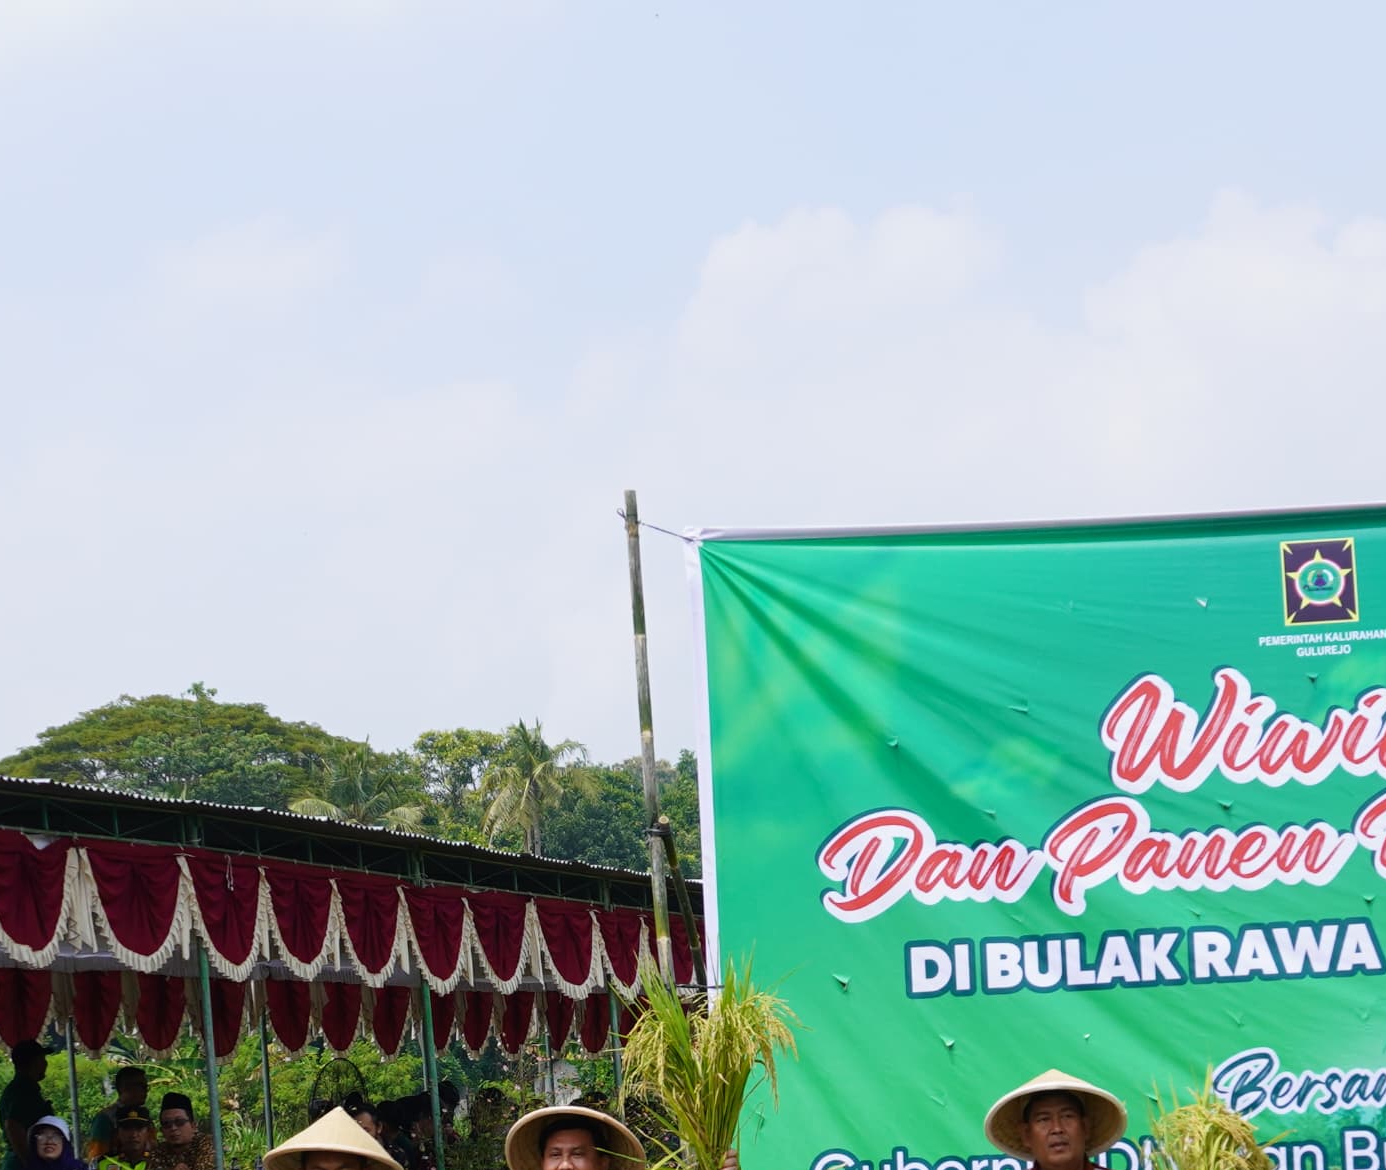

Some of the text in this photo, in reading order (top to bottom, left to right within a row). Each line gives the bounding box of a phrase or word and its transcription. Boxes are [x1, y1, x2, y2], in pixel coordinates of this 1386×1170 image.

[1258, 632, 1323, 647] PEMERINTAH
[1296, 644, 1351, 657] GULUREJO
[821, 812, 1037, 913] Dan
[1046, 798, 1347, 906] Panen
[910, 943, 971, 993] DI
[984, 932, 1182, 990] BULAK
[1191, 923, 1382, 979] RAWA
